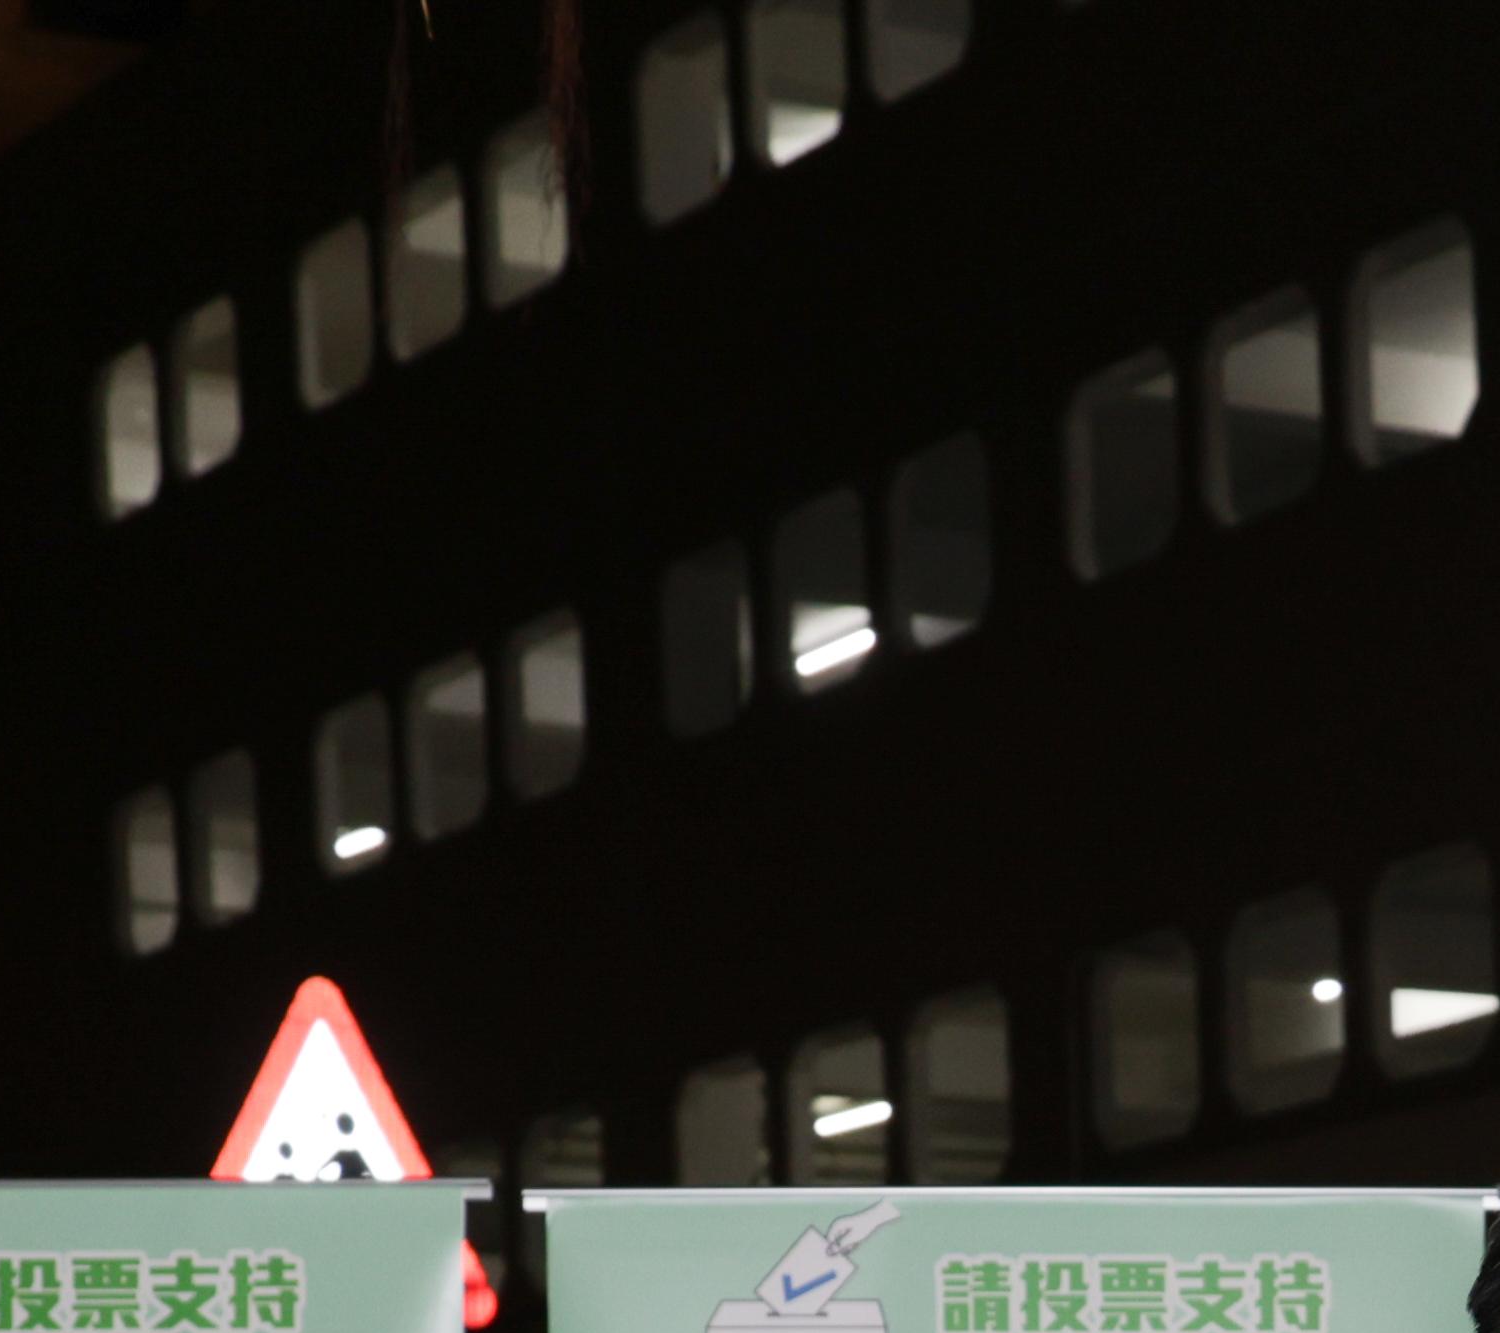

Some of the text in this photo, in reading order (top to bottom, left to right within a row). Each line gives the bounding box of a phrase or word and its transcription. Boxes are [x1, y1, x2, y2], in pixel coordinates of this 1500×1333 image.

[940, 1258, 1325, 1333] 請投票支持
